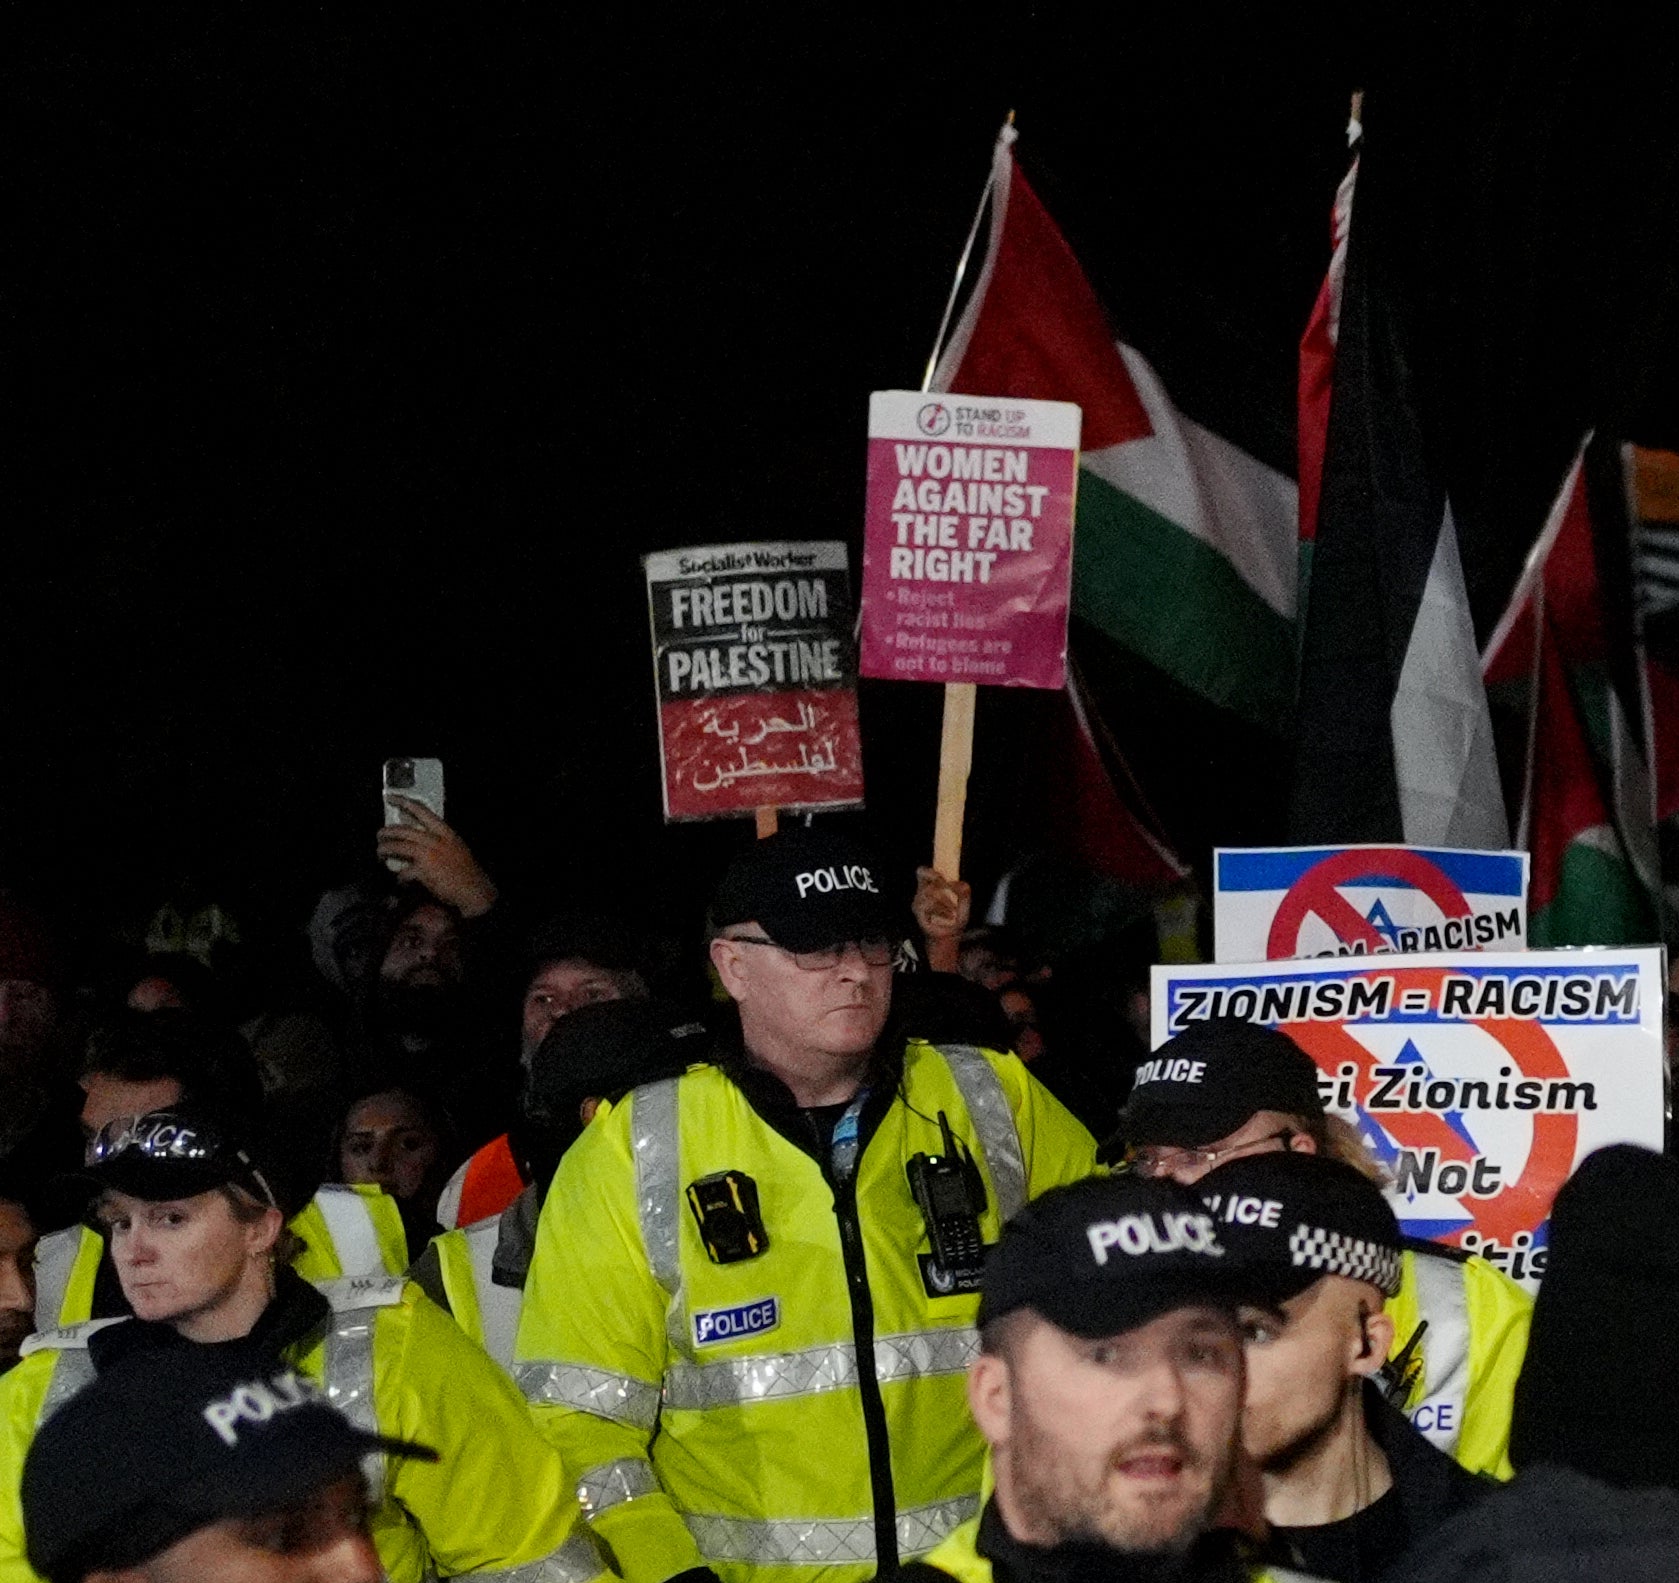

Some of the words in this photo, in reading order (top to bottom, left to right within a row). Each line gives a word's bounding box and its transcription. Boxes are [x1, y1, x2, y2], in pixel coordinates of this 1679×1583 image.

[956, 407, 1000, 422] STAND
[956, 422, 974, 436] TO
[895, 443, 1029, 482] WOMEN
[892, 479, 1048, 517] AGAINST
[891, 512, 959, 547] THE
[967, 518, 1034, 551] FAR
[890, 547, 997, 584] RIGHT
[671, 578, 828, 629] FREEDOM
[740, 622, 767, 644] for
[668, 639, 842, 692] PALESTINE
[796, 865, 879, 899] POLICE
[1399, 907, 1522, 953] RACISM
[1173, 979, 1392, 1027] ZIONISM
[1442, 977, 1638, 1017] RACISM
[1369, 1067, 1598, 1110] Zionism
[1399, 1149, 1501, 1196] Not
[698, 1303, 774, 1342] POLICE
